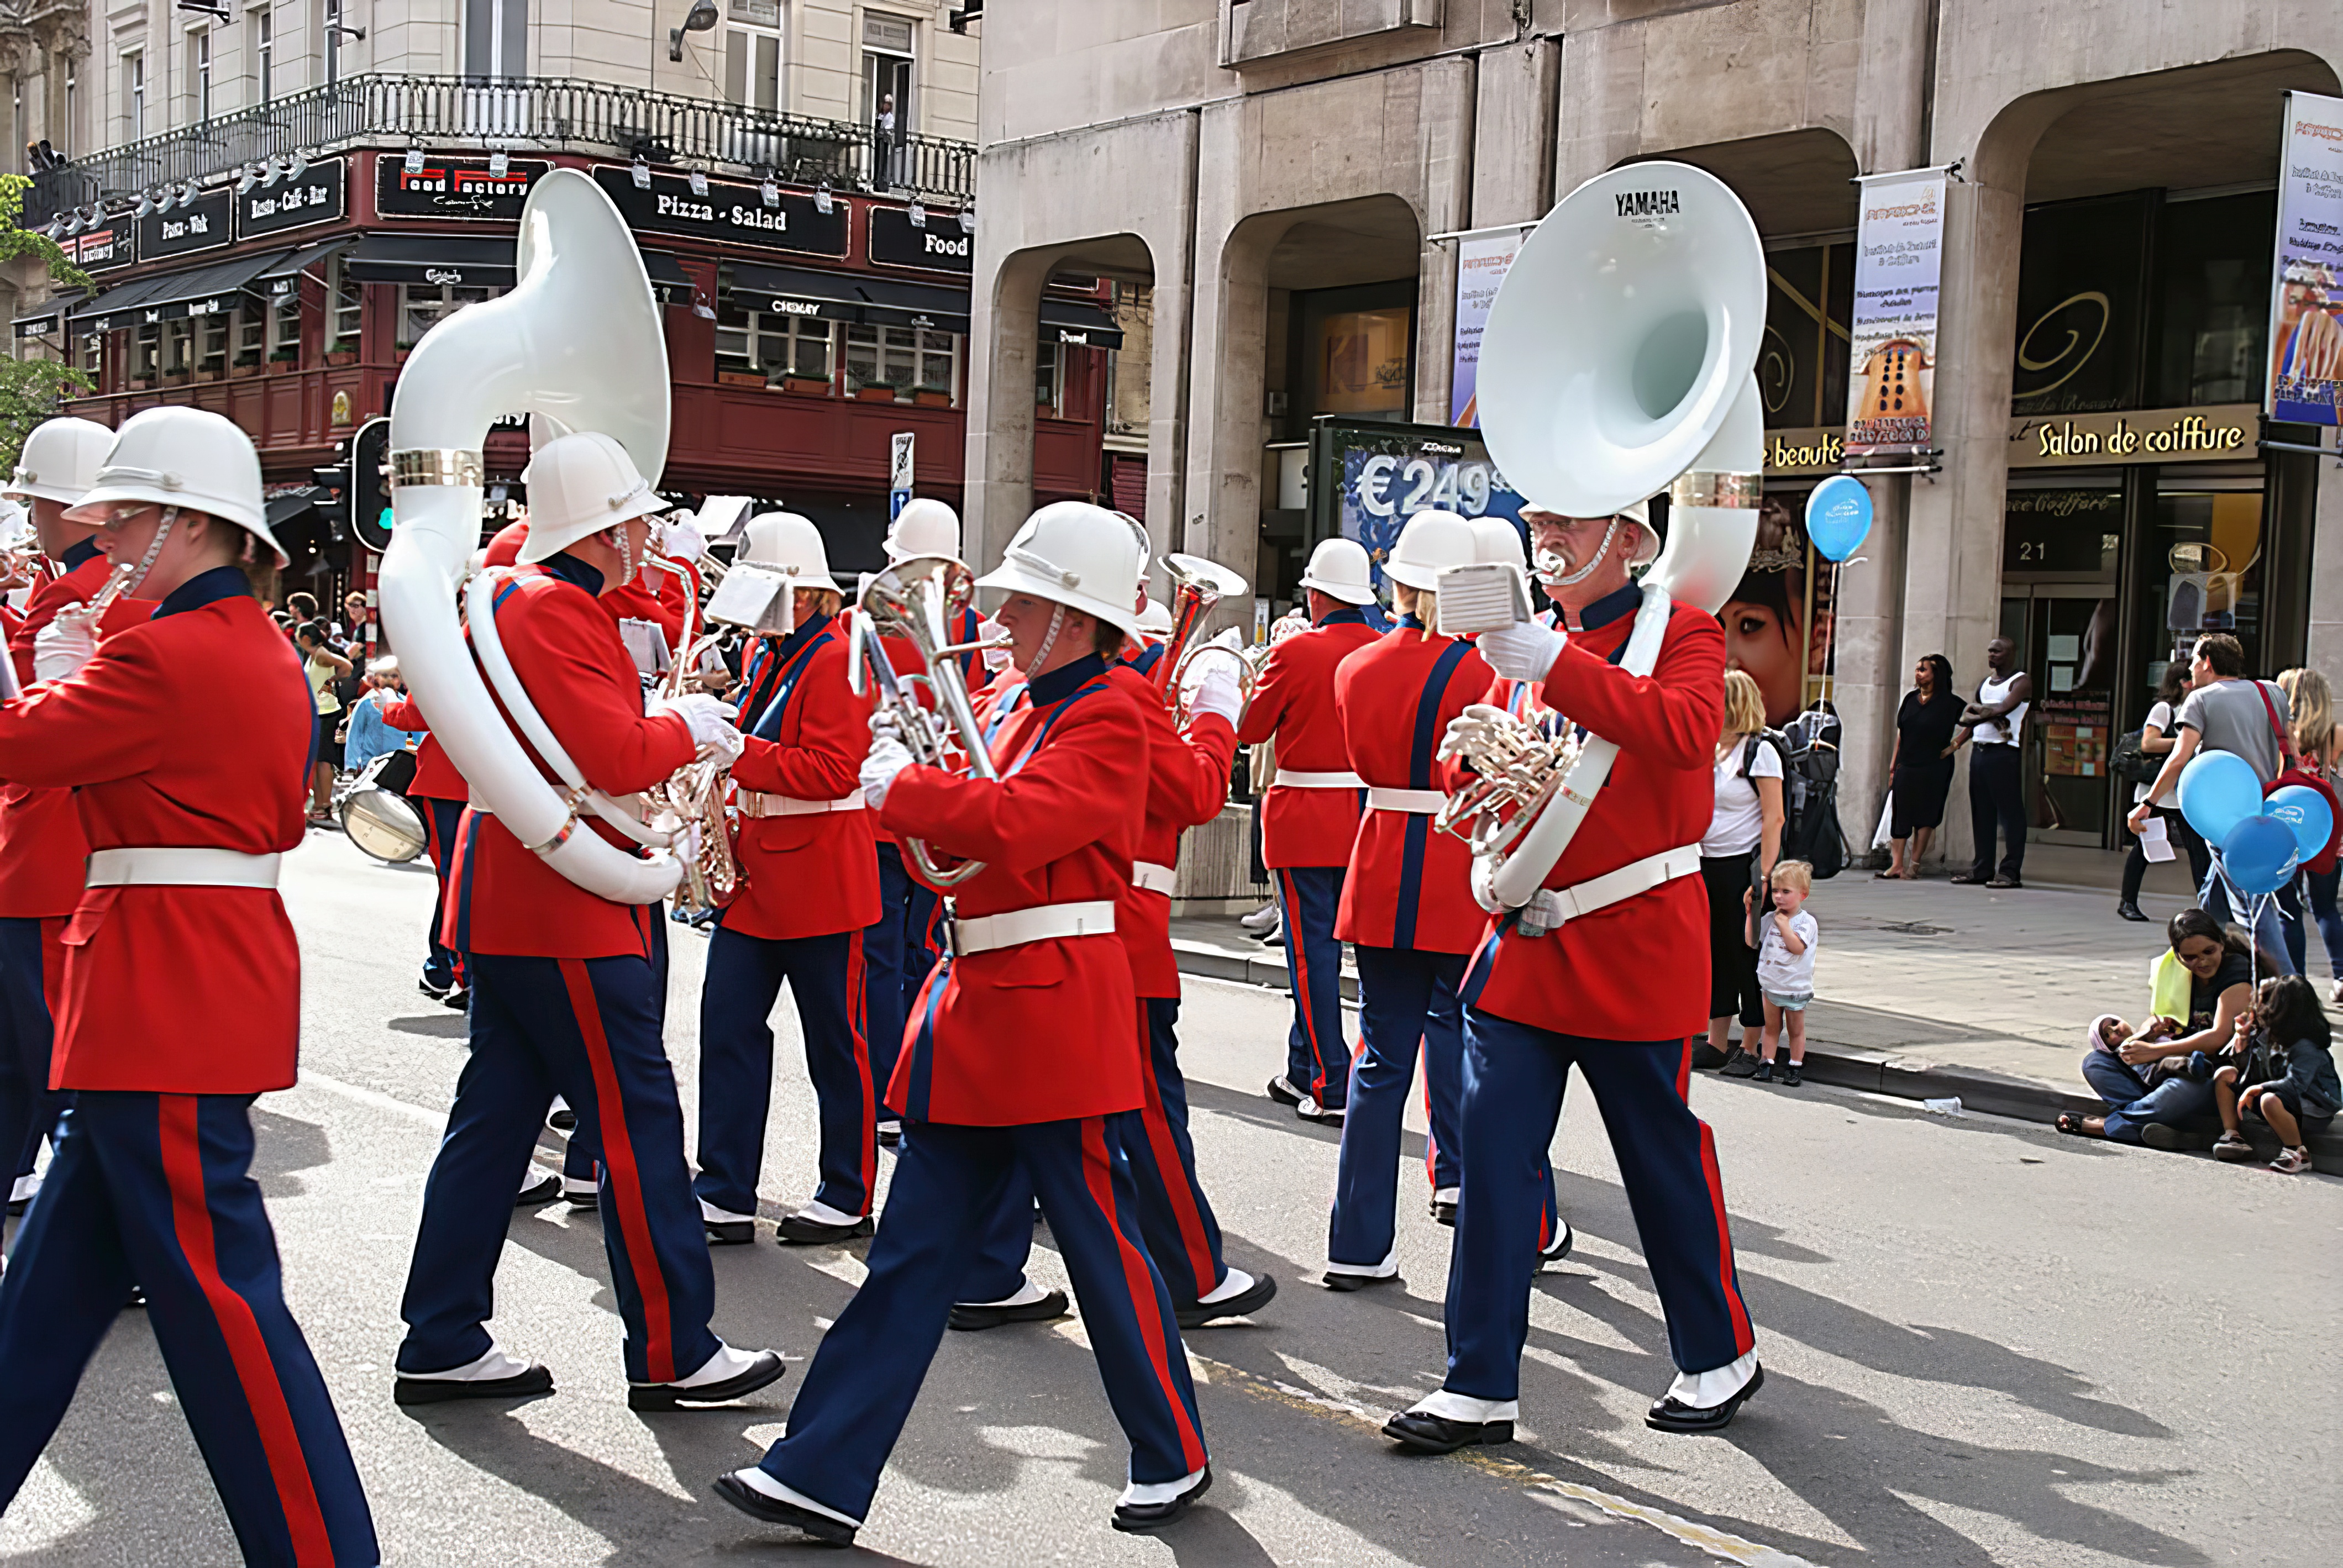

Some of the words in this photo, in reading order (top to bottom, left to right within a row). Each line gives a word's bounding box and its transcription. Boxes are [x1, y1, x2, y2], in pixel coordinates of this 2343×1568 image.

[400, 167, 446, 191] Food
[454, 170, 528, 195] Factory
[657, 194, 713, 220] Pizza
[731, 206, 787, 231] Salad
[1615, 190, 1680, 216] YAMAHA
[924, 233, 968, 256] Food
[2039, 421, 2098, 456] Salon
[2108, 421, 2137, 453] de
[2145, 415, 2242, 452] coiffure
[1775, 433, 1841, 467] beauté
[2020, 541, 2045, 560] 21
